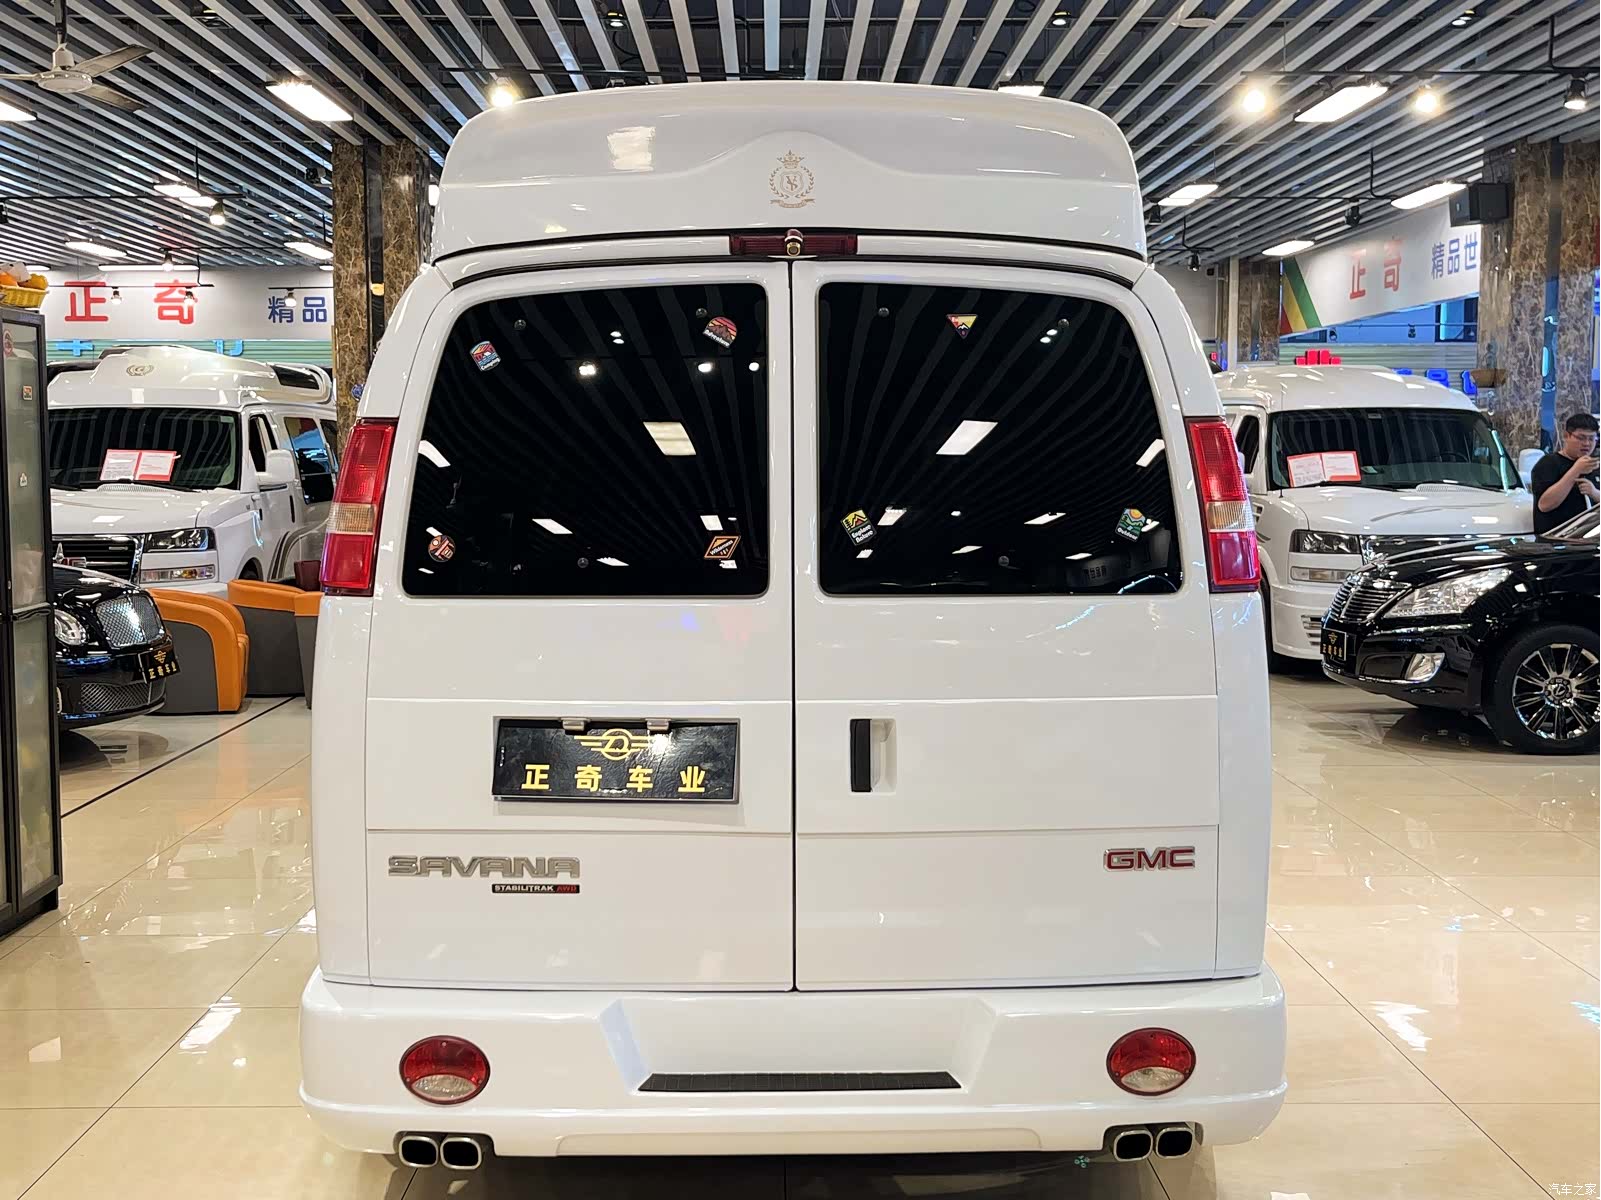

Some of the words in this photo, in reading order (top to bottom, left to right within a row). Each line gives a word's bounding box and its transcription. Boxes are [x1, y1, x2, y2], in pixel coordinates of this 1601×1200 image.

[64, 279, 199, 325] 正奇
[521, 763, 706, 793] 正奇车业
[388, 855, 580, 878] SAVANA
[1103, 845, 1196, 871] GMC
[494, 884, 554, 893] STABILITRAK
[556, 884, 577, 893] AWD
